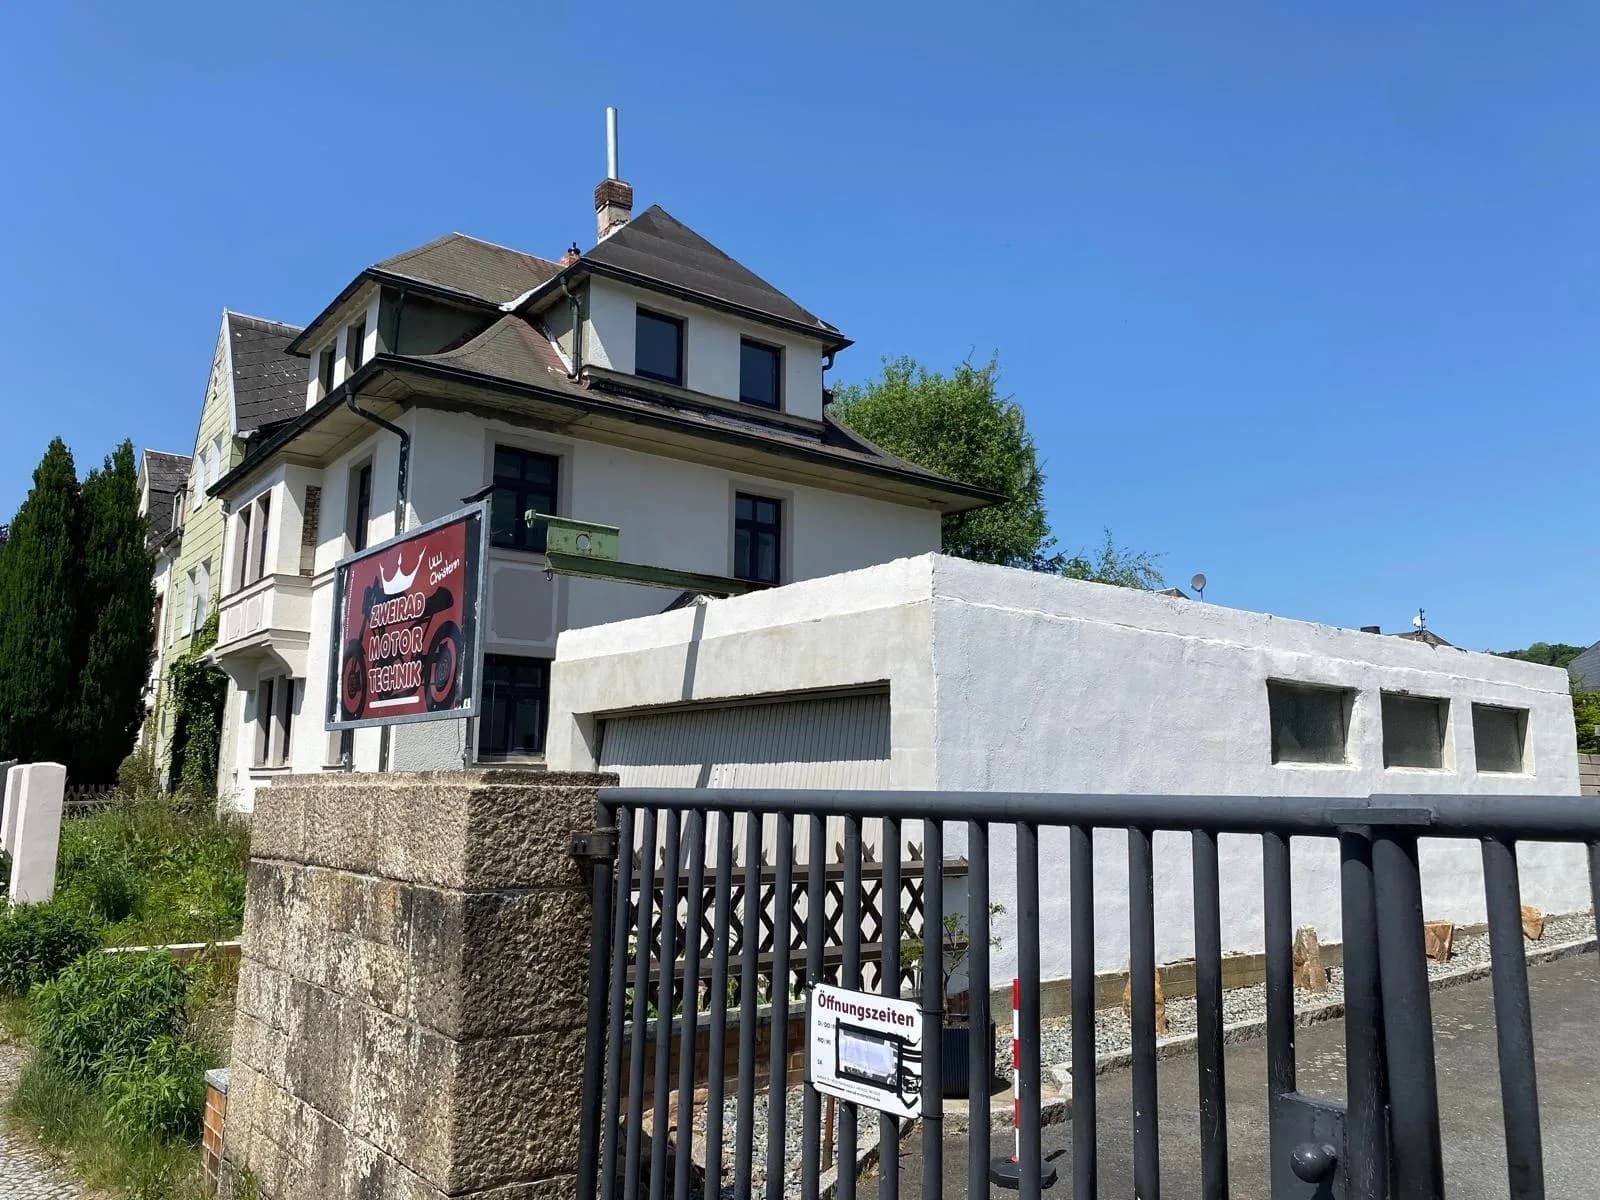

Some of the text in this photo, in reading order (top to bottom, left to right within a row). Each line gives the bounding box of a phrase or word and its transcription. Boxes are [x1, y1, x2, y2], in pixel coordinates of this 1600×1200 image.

[369, 592, 425, 628] ZWEIRAD
[369, 627, 423, 661] MOTOR
[368, 660, 422, 693] TECHNIK
[818, 989, 914, 1027] Öffnungszeiten
